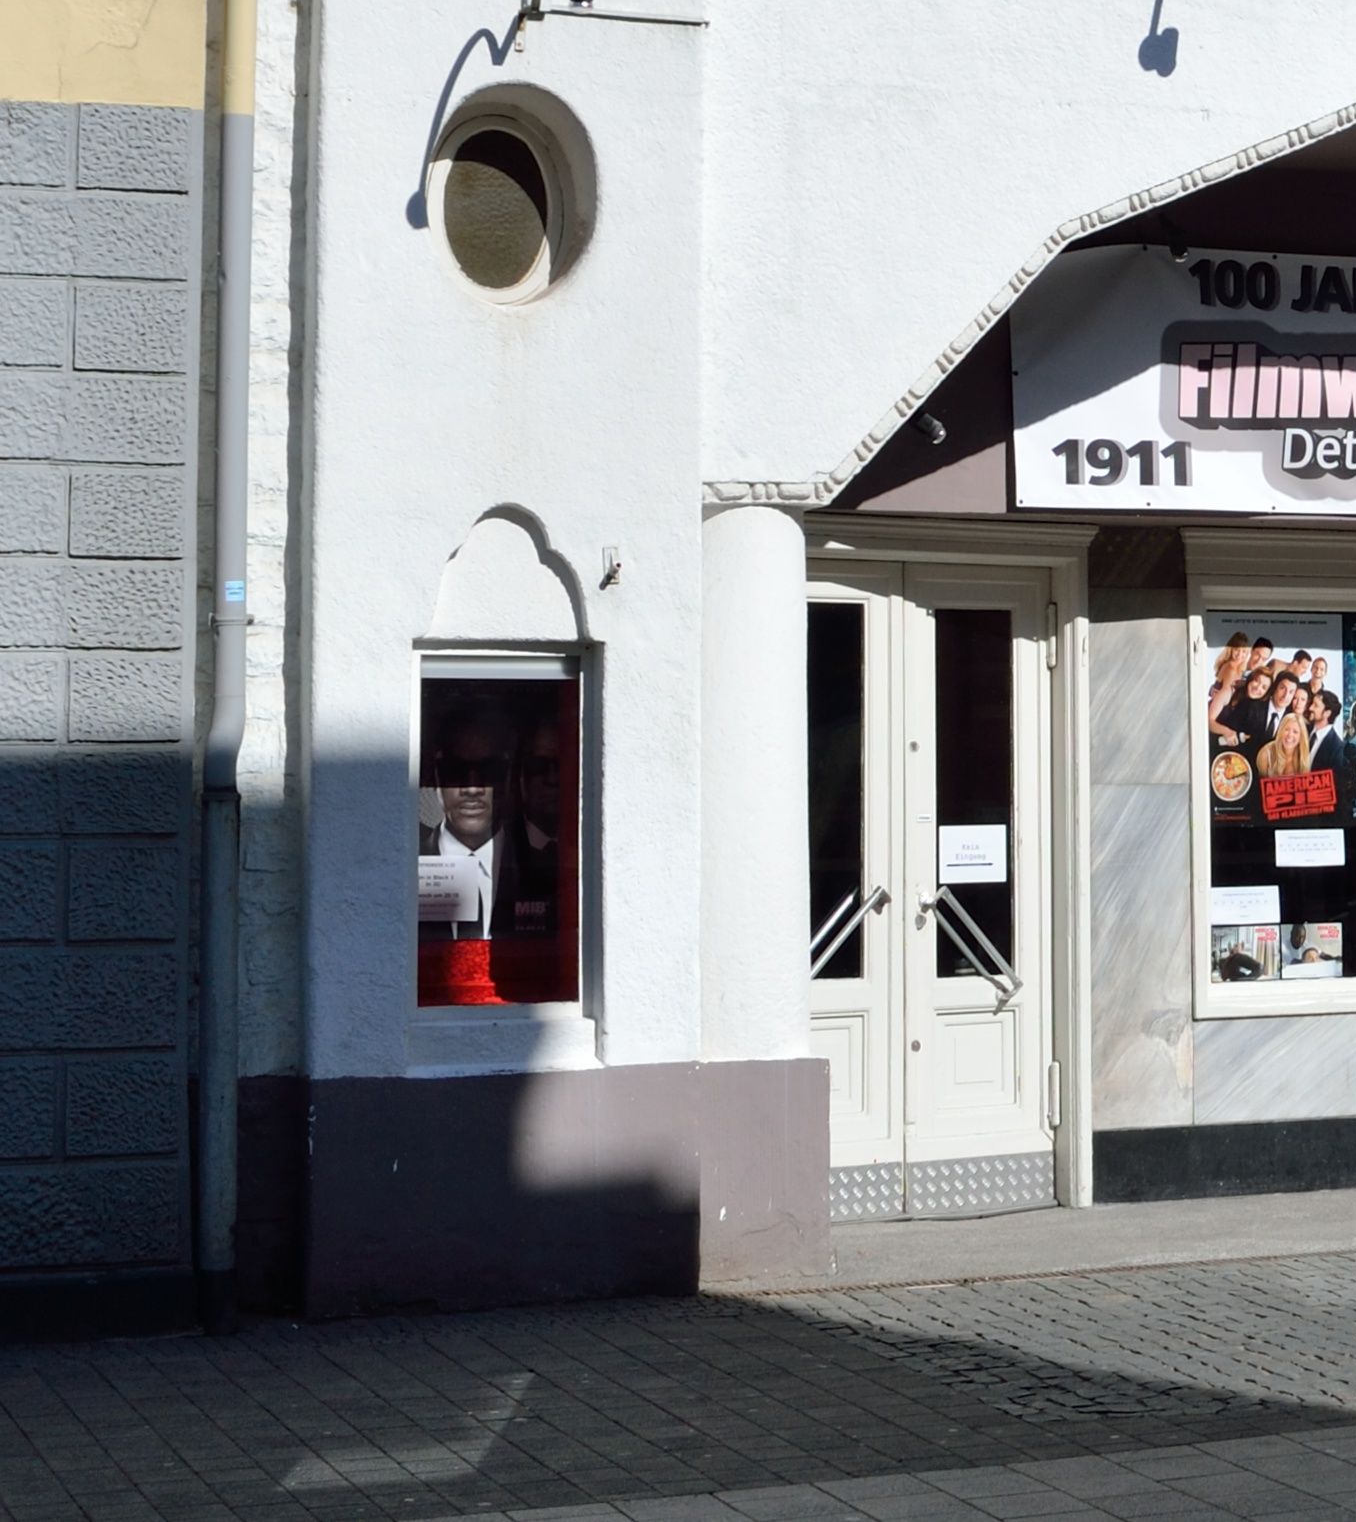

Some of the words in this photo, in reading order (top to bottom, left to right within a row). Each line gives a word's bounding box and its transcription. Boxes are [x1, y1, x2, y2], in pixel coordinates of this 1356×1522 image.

[1189, 259, 1278, 310] 100
[1052, 439, 1191, 486] 1911
[1265, 773, 1332, 795] AMERICAN
[1266, 789, 1333, 809] PIE
[514, 901, 546, 917] MIB
